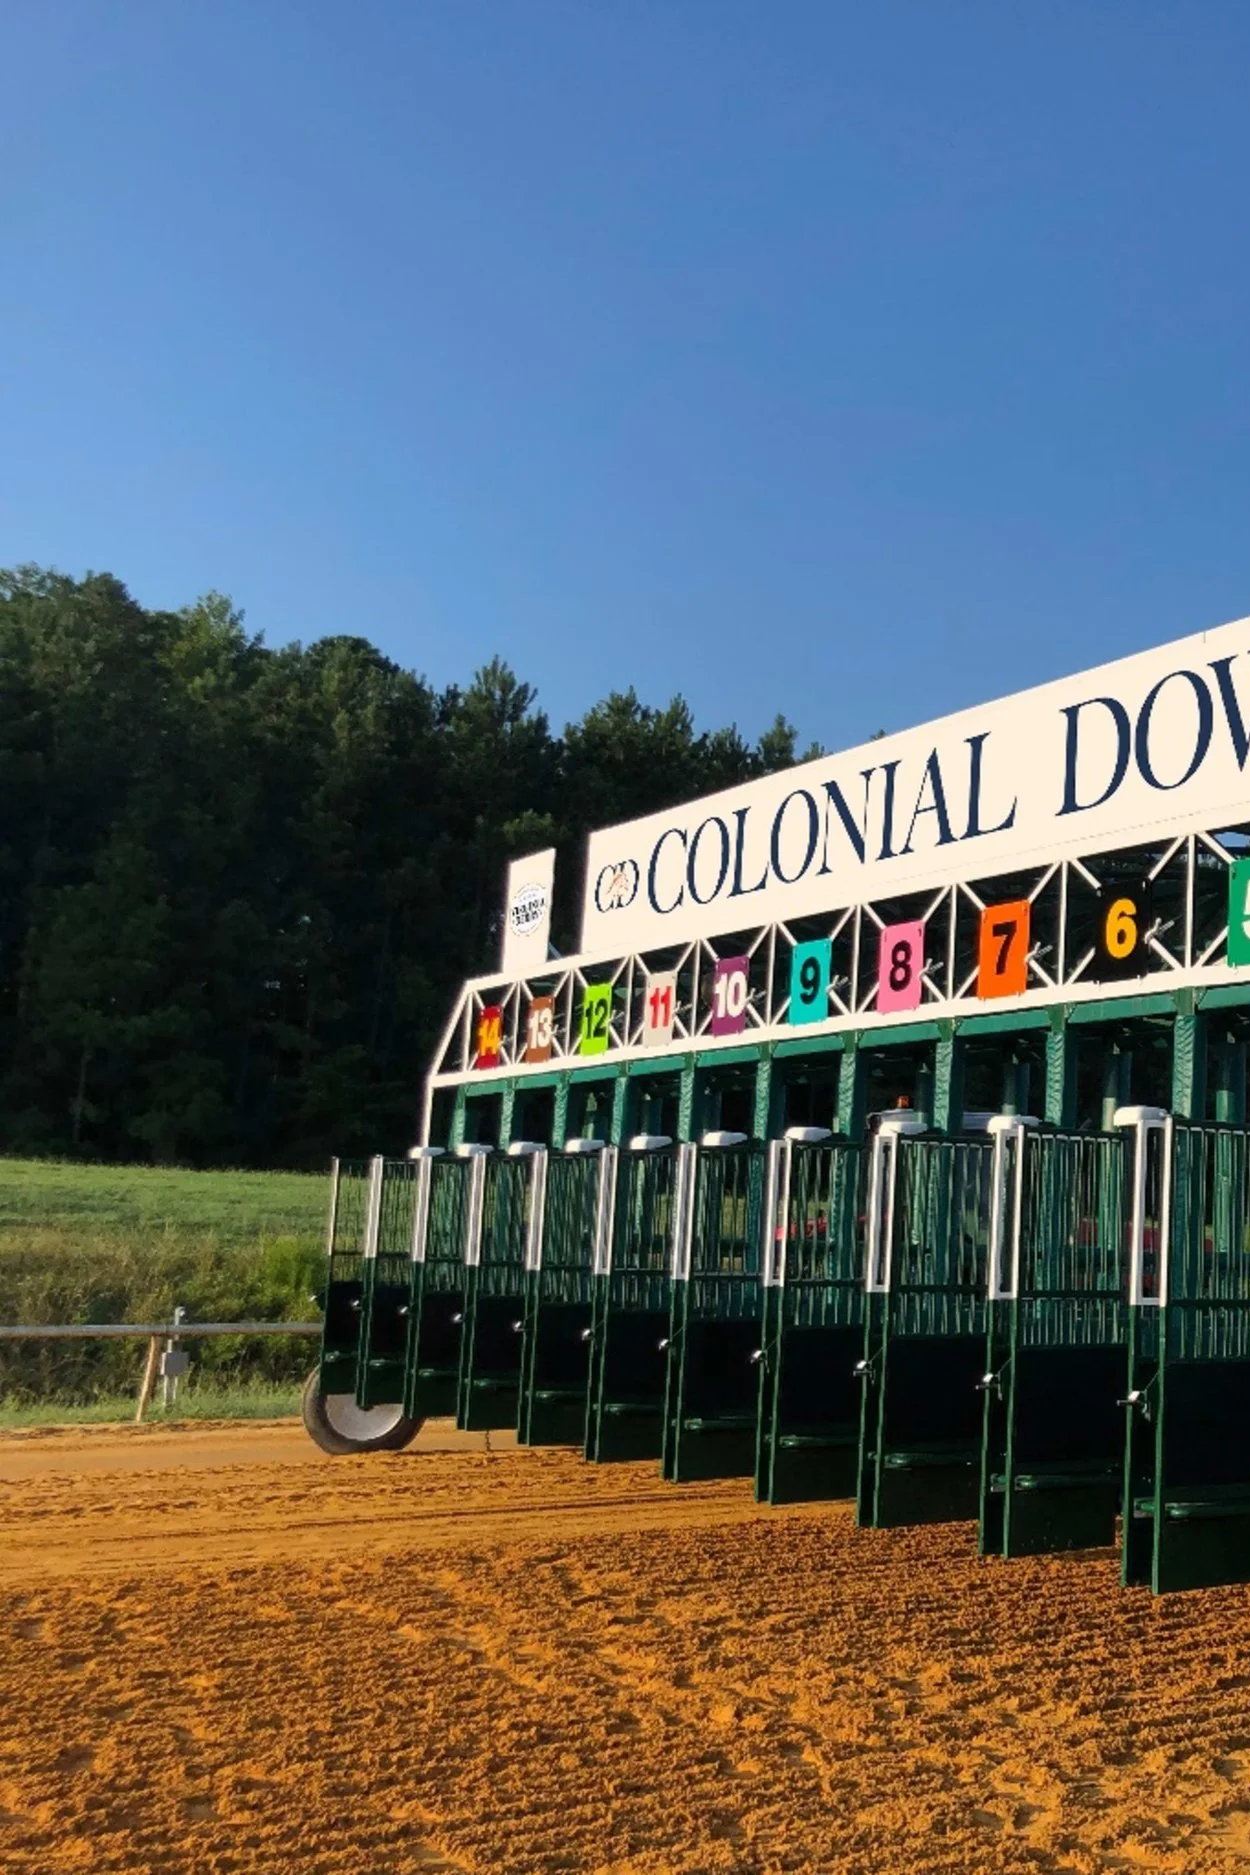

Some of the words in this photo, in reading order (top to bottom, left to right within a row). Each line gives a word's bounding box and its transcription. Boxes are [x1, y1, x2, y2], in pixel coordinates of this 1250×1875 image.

[648, 731, 1017, 914] COLONIAL
[994, 921, 1018, 975] 7
[1105, 899, 1137, 958] 6
[800, 957, 821, 1004] 9
[890, 940, 912, 991] 8
[650, 986, 672, 1028] 11
[715, 971, 747, 1018] 10
[477, 1014, 499, 1056] 14
[529, 1011, 550, 1049] 13
[584, 998, 608, 1039] 12
